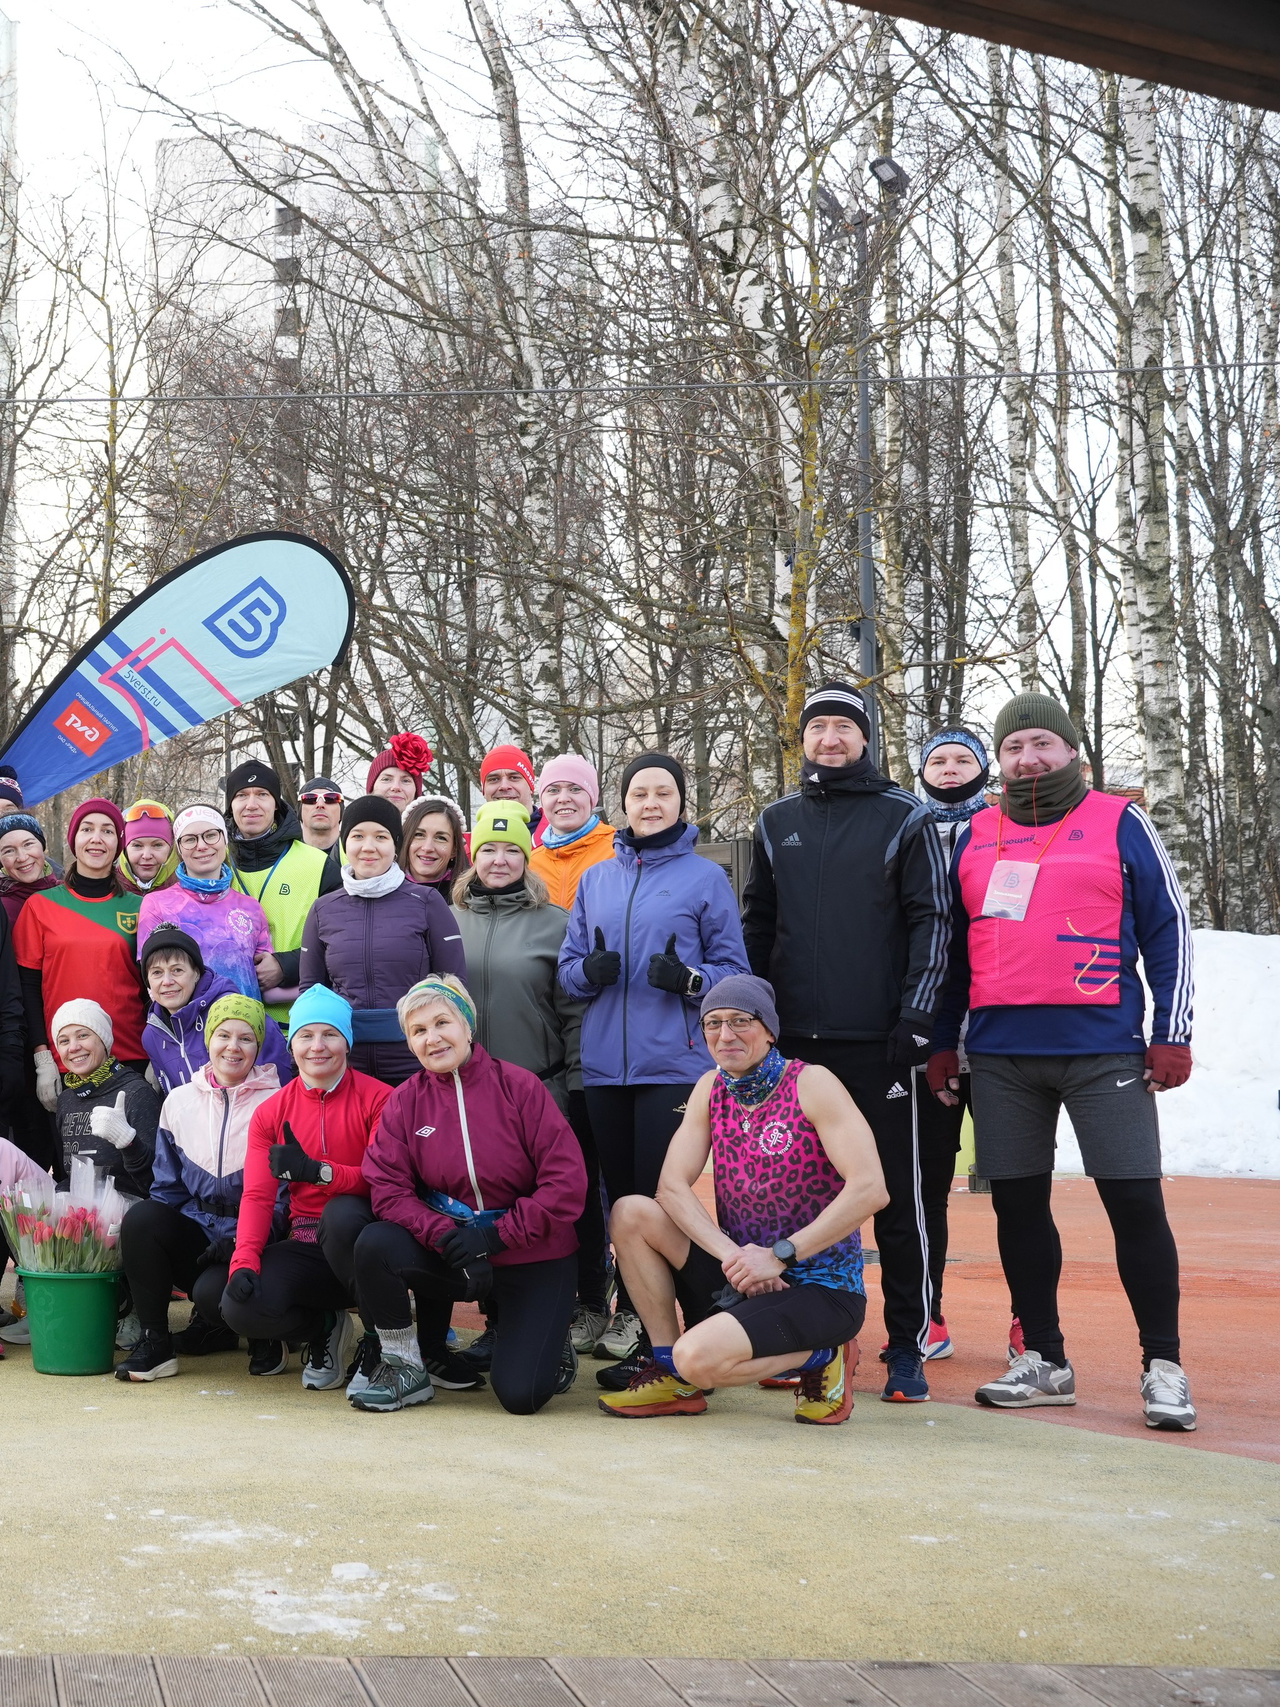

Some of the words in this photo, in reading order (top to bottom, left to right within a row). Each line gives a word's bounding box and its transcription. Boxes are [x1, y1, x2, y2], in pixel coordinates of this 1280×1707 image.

[123, 669, 162, 707] 5verst.ru
[75, 692, 104, 719] ОФИЦИАЛЬНЫЙ
[102, 716, 119, 733] ПАРТНЕР
[886, 1091, 909, 1100] adidas
